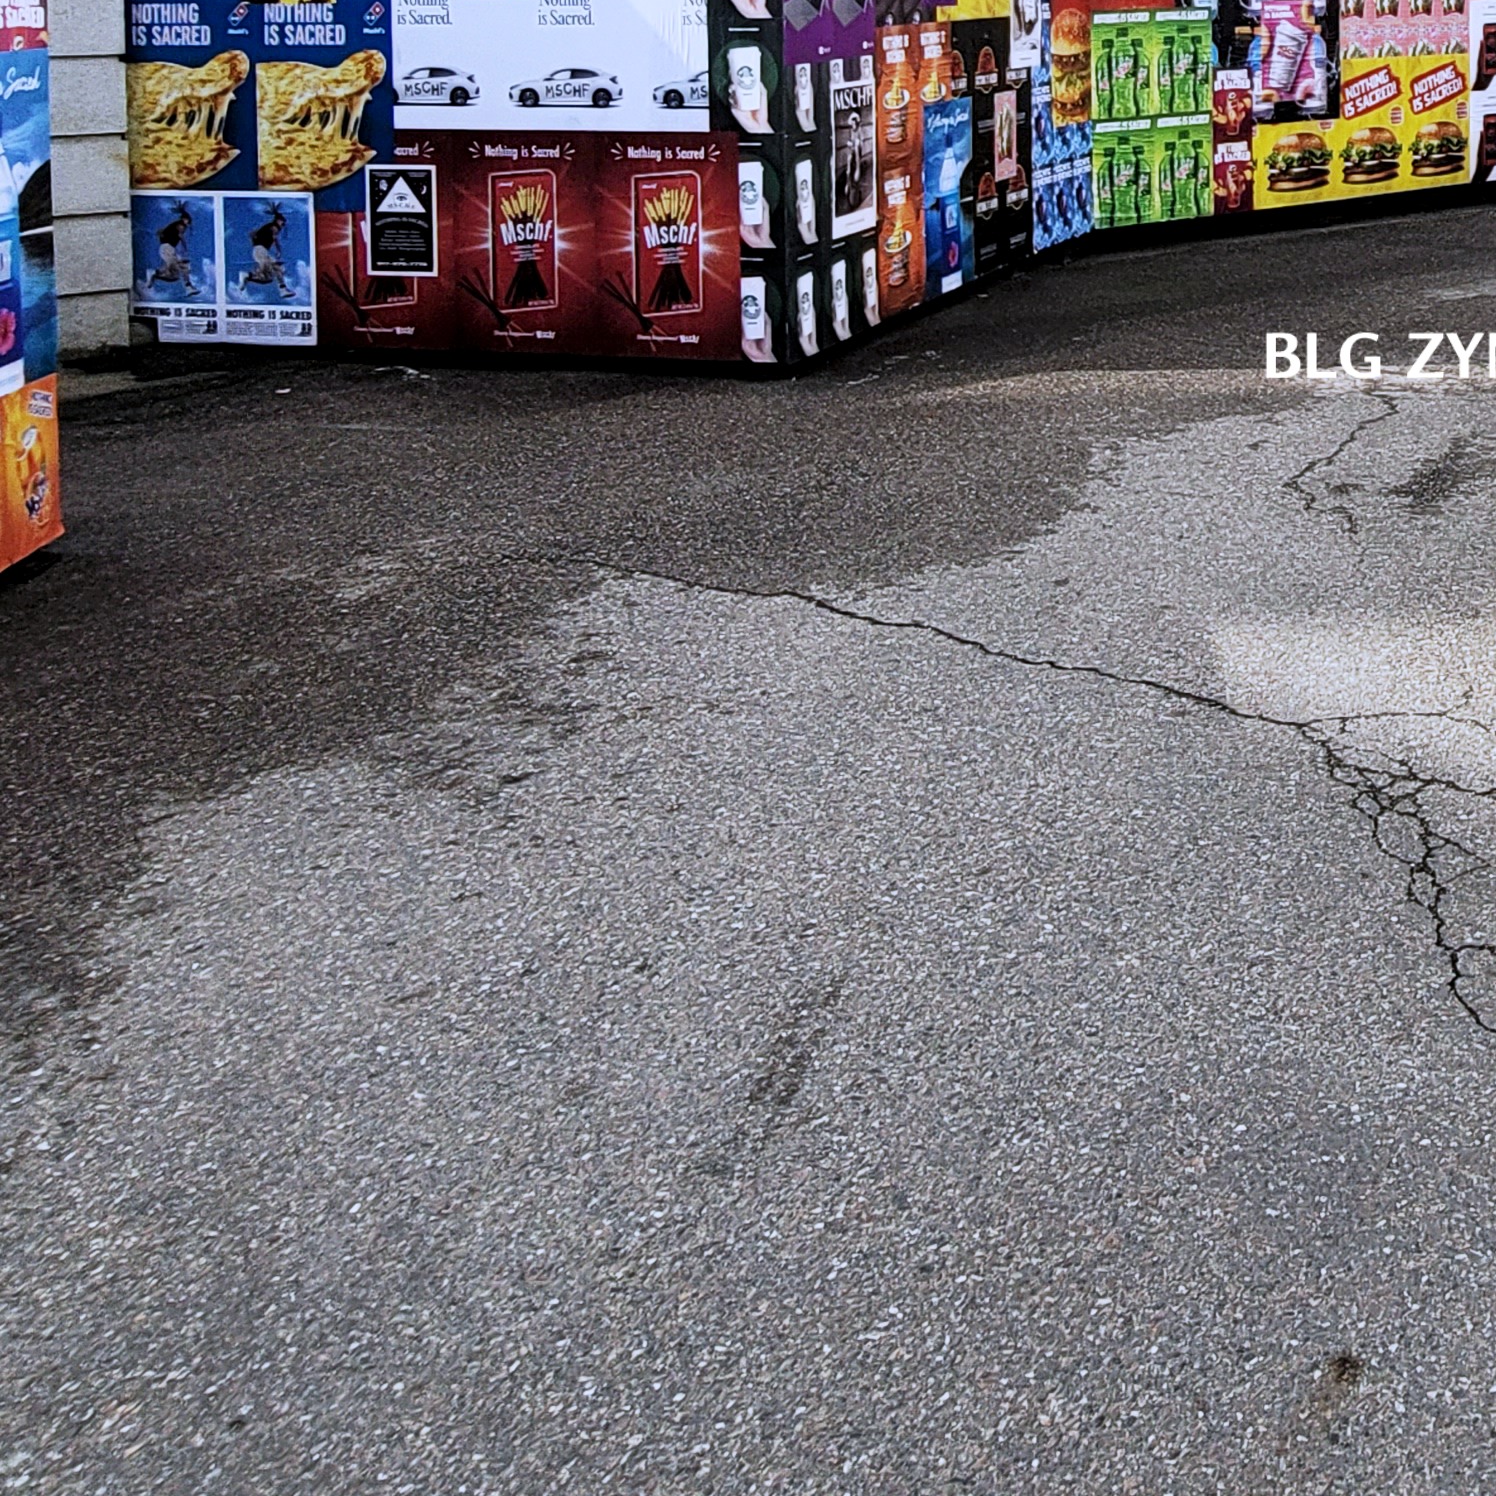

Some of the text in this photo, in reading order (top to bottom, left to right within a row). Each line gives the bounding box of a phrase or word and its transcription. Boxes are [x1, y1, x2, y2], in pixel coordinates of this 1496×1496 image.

[132, 2, 199, 25] NOTHING
[263, 2, 334, 24] NOTHING
[397, 10, 407, 25] is
[538, 11, 548, 26] is
[132, 25, 211, 46] IS SACRED
[264, 24, 347, 46] IS SACRED
[404, 81, 448, 97] MSCHF
[1344, 68, 1390, 101] NOTHING
[1413, 64, 1455, 97] NOTHING
[545, 83, 591, 99] MSCHF
[835, 85, 873, 110] MSCHF
[1344, 100, 1355, 116] IS
[1412, 96, 1423, 111] IS
[485, 144, 561, 160] Nothing is Sacred
[627, 146, 705, 162] Nothing is Sacred
[500, 220, 553, 246] Mschf
[643, 222, 697, 249] Mschf
[226, 309, 312, 321] NOTHING IS SACRED
